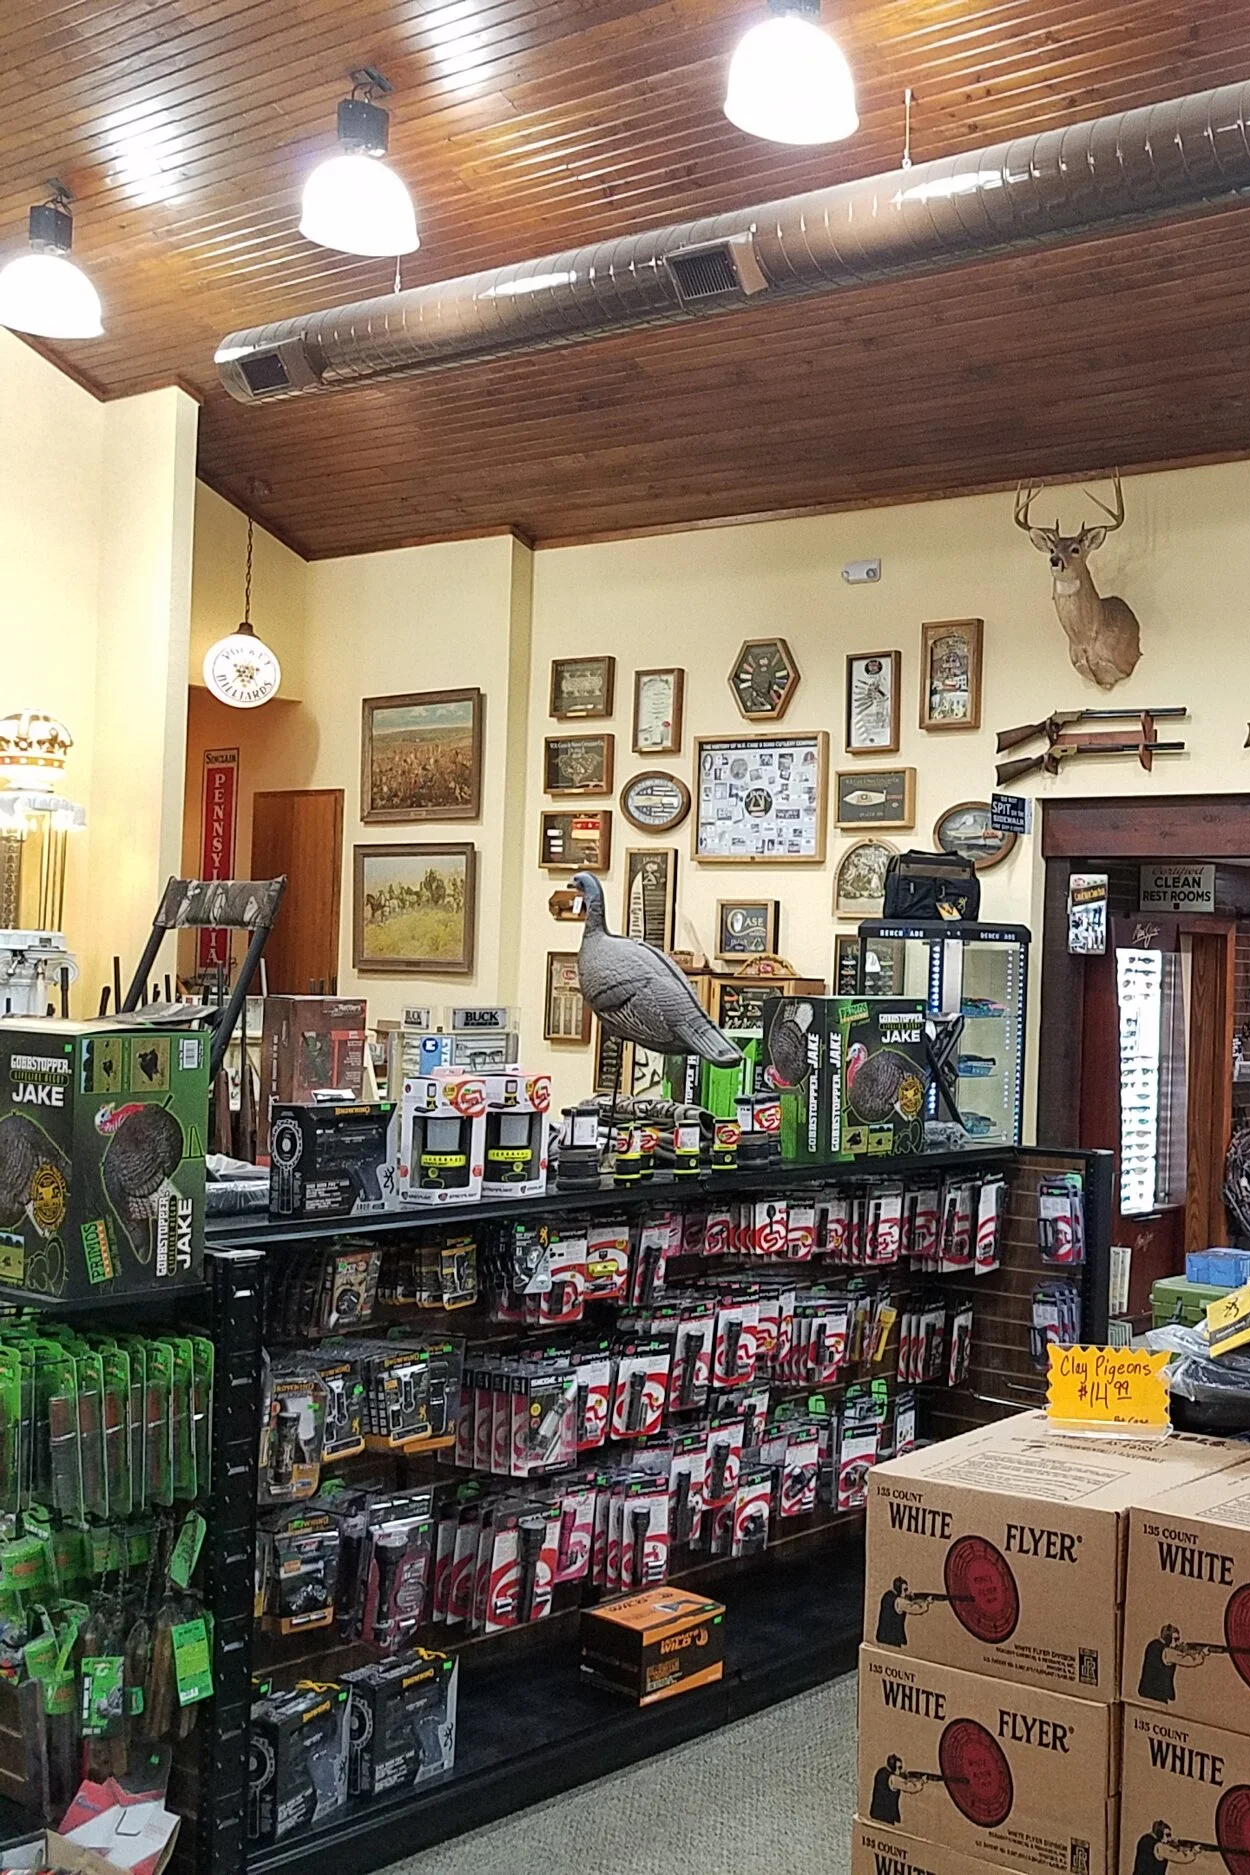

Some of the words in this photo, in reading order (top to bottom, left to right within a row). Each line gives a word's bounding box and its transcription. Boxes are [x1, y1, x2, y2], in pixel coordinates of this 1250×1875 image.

[992, 801, 1011, 815] SPIT
[993, 815, 1024, 825] SIDEWALK
[206, 773, 227, 964] PENNSYLIA
[1154, 877, 1201, 888] CLEAN
[1143, 891, 1167, 901] REST
[1170, 891, 1211, 901] ROOMS
[880, 929, 924, 937] BENCHADE
[980, 932, 1015, 940] BENCHADE
[465, 1012, 499, 1022] BUCK
[882, 1030, 921, 1043] JAKE
[808, 1032, 819, 1068] JAKE
[830, 1032, 841, 1068] JAKE
[12, 1086, 64, 1107] JAKE
[177, 1199, 192, 1269] JAKE
[84, 1224, 105, 1280] PRIMOS
[1060, 1356, 1088, 1389] Clay
[1095, 1355, 1151, 1383] Pigeons
[876, 1486, 891, 1498] 135
[892, 1489, 923, 1503] COUNT
[888, 1502, 953, 1540] WHITE
[1004, 1524, 1078, 1563] FLYER
[1143, 1524, 1160, 1537] 135
[1162, 1528, 1198, 1545] COUNT
[1157, 1541, 1234, 1586] WHITE
[868, 1663, 883, 1675] 135
[884, 1665, 916, 1683] COUNT
[882, 1679, 947, 1721] WHITE
[998, 1709, 1070, 1754] FLYER
[1134, 1719, 1150, 1732] 135
[1153, 1725, 1189, 1743] COUNT
[1148, 1737, 1225, 1787] WHITE
[862, 1836, 875, 1848] 135
[877, 1841, 907, 1860] COUNT
